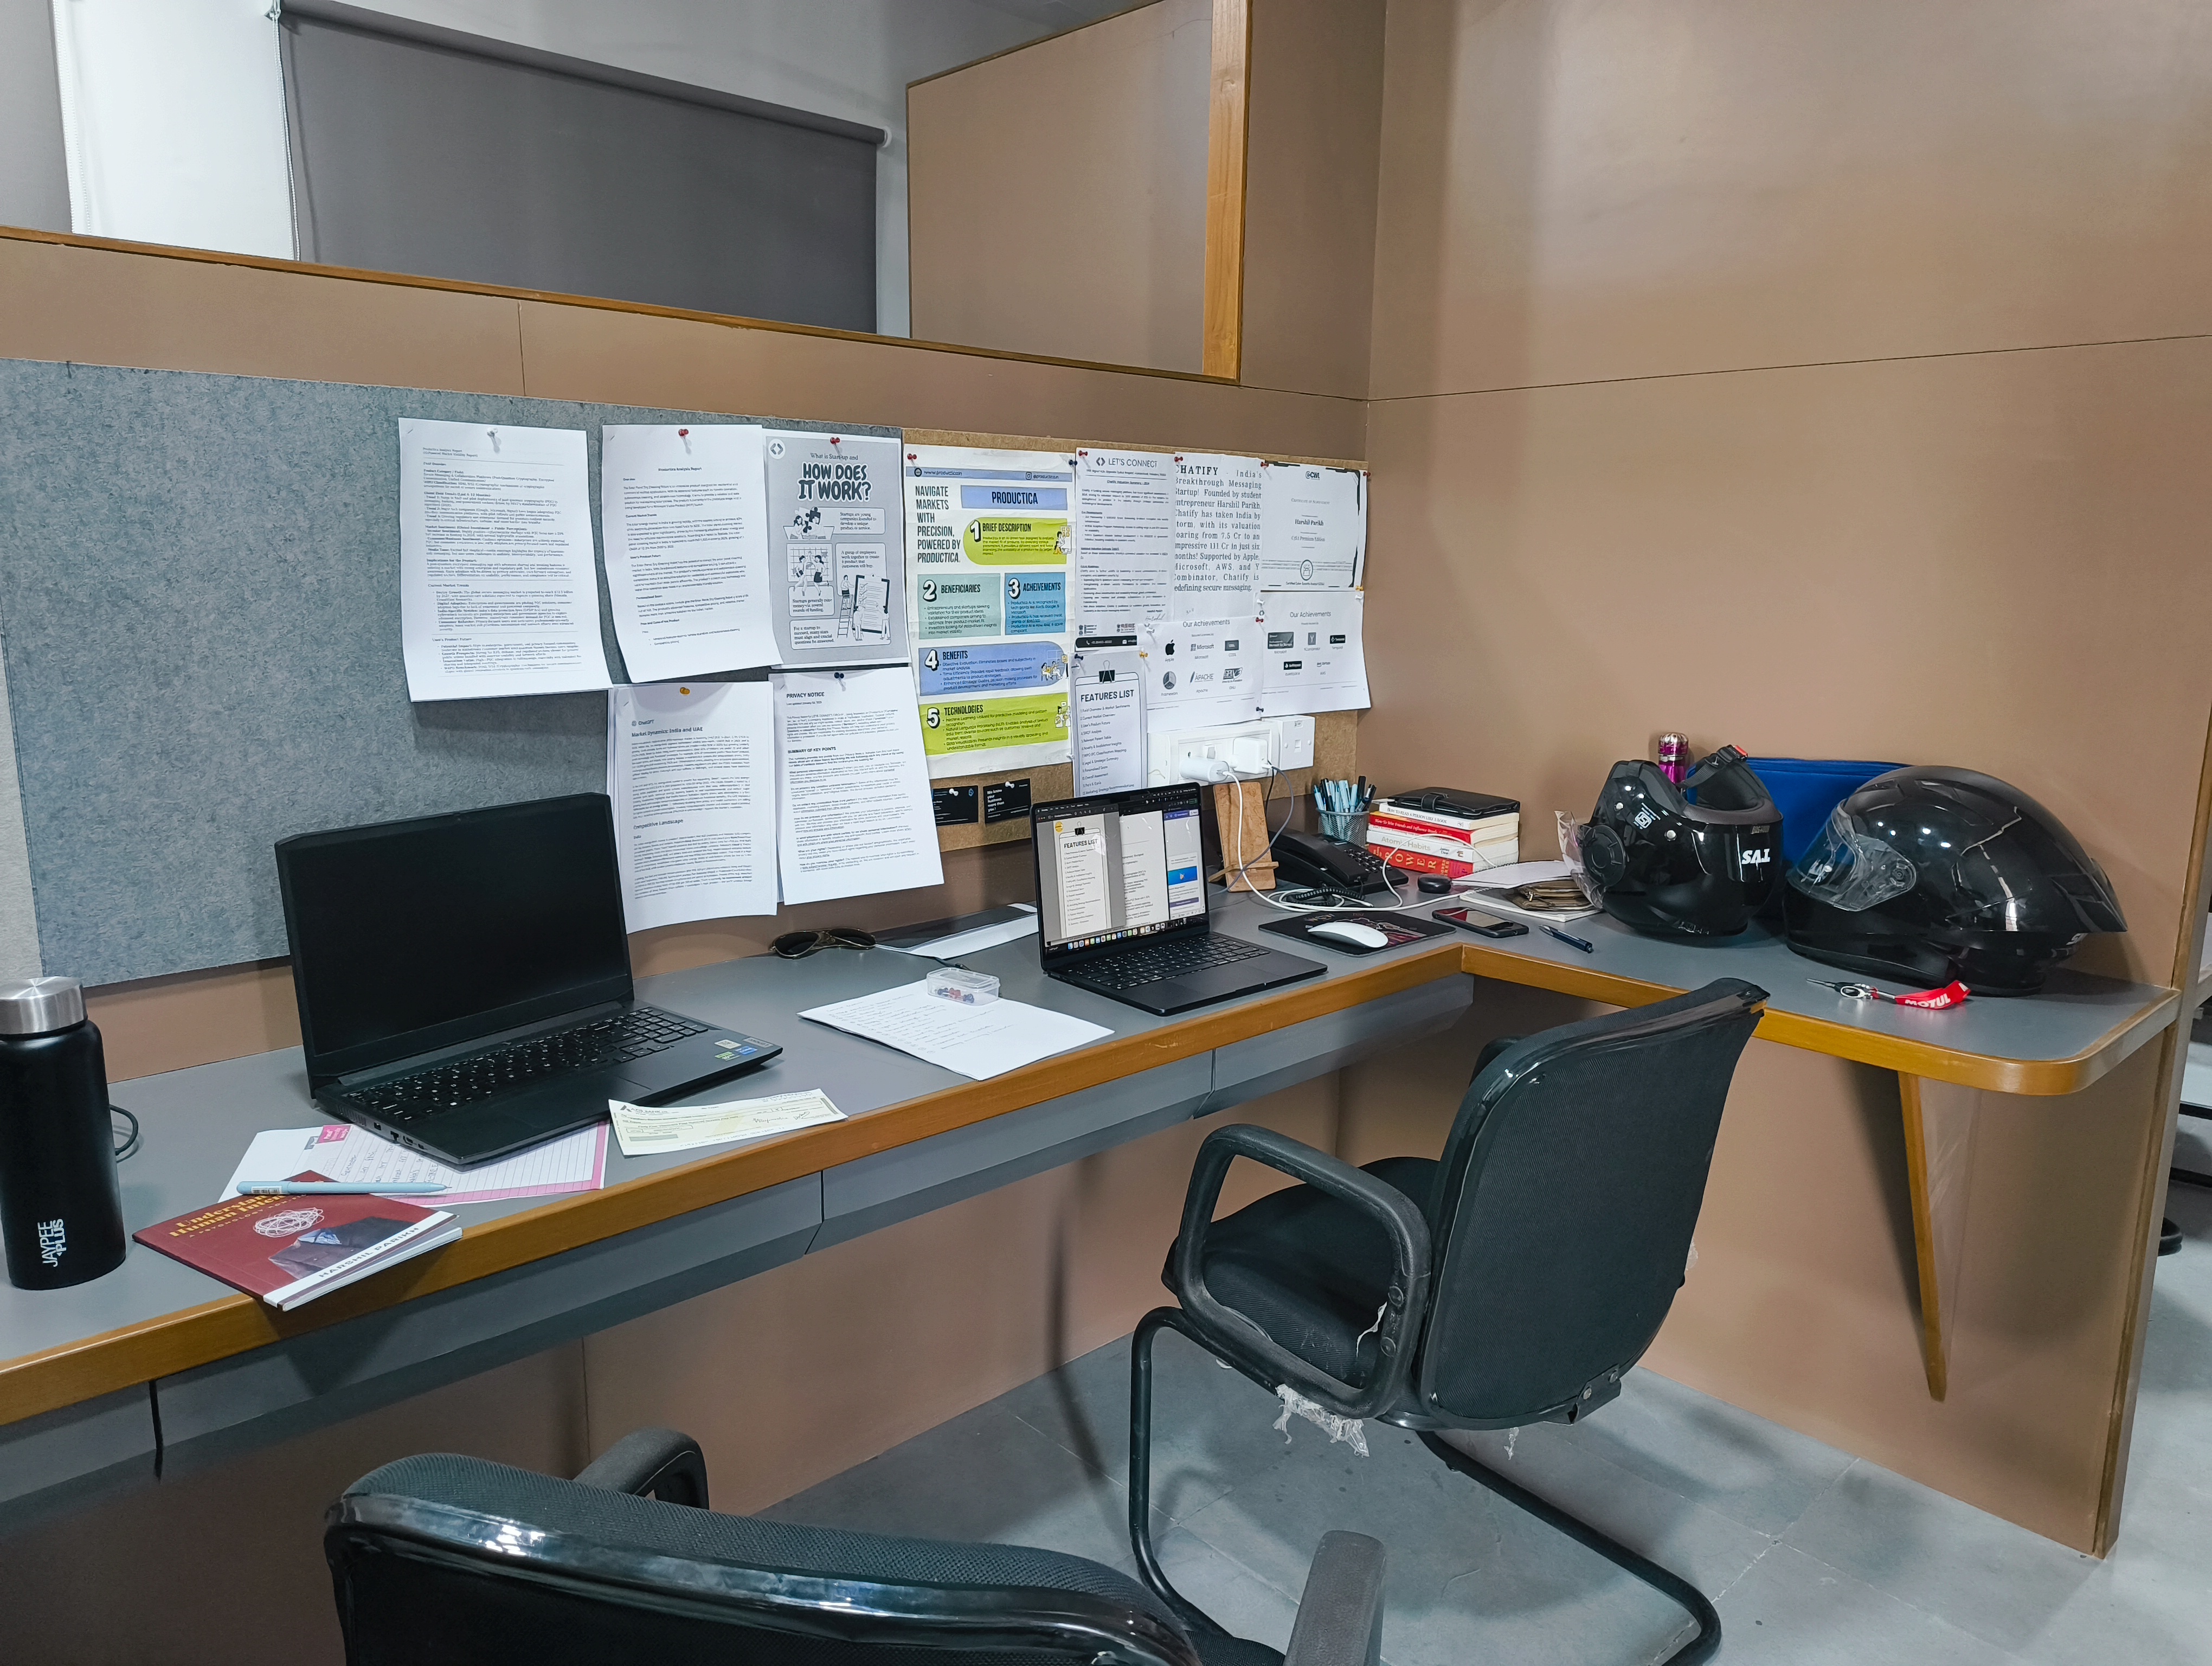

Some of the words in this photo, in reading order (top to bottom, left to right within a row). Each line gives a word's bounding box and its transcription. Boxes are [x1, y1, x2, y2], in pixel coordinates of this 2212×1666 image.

[1108, 458, 1124, 466] LET'S
[1127, 459, 1158, 467] CONNECT
[803, 463, 832, 480] HOW
[835, 465, 867, 480] DOES
[1236, 470, 1262, 478] India's
[799, 480, 815, 499] IT
[818, 481, 871, 501] WORK?
[1229, 480, 1262, 490] Messaging
[915, 485, 949, 497] NAVIGATE
[1175, 488, 1199, 497] tartup!
[1204, 489, 1230, 497] Founded
[1232, 491, 1239, 499] by
[992, 492, 1038, 504] PRODUCTICA
[1175, 499, 1215, 508] ntrepreneur
[1217, 500, 1239, 508] Harshil
[916, 499, 949, 510] MARKETS
[917, 512, 935, 523] WITH
[917, 526, 955, 537] PRECISION,
[970, 520, 981, 542] 1
[982, 523, 997, 532] BRIEF
[999, 523, 1031, 532] DESCRIPTION
[917, 539, 950, 550] POWERED
[951, 540, 961, 550] BY
[1175, 542, 1207, 550] mpressive
[917, 552, 961, 563] PRODUCTICA.
[1200, 553, 1231, 561] Supported
[1223, 573, 1249, 581] Chatify
[923, 579, 937, 602] 2
[941, 584, 980, 594] BENEFICIARIES
[1008, 578, 1020, 599] 3
[1174, 584, 1202, 592] edefining
[1194, 619, 1230, 627] Achievements
[924, 649, 940, 671] 4
[943, 651, 968, 661] BENEFITS
[1081, 691, 1117, 702] FEATURES
[1119, 689, 1135, 698] LIST
[927, 707, 941, 729] 5
[944, 704, 983, 716] TECHNOLOGIES
[1064, 840, 1088, 849] FEATURES
[1381, 836, 1406, 847] Atomic
[1407, 841, 1431, 851] Habits
[1905, 993, 1951, 1008] MOTUL
[169, 1212, 237, 1237] Human
[53, 1219, 67, 1253] PLUS
[37, 1220, 58, 1267] JAYPEE
[318, 1251, 374, 1278] HARSHIL
[374, 1227, 420, 1251] PARIKH
